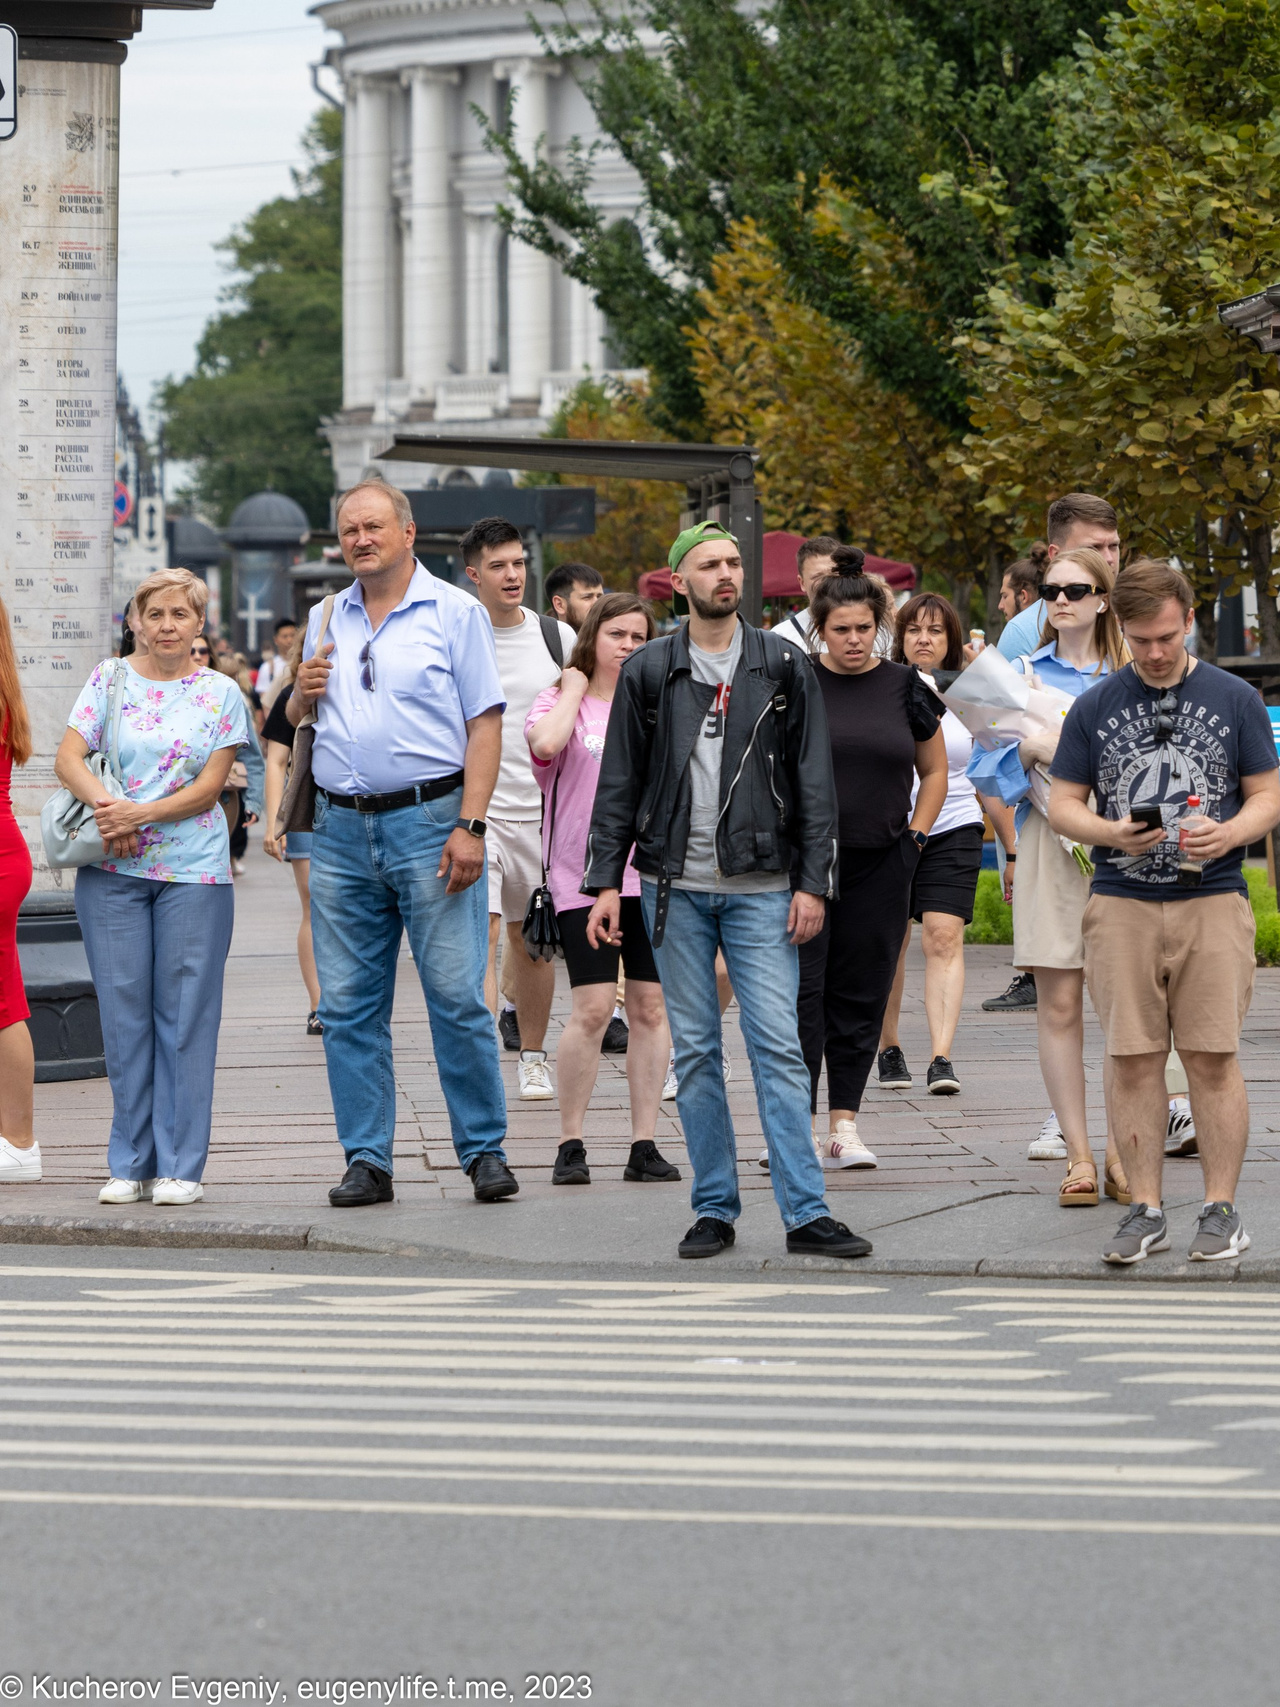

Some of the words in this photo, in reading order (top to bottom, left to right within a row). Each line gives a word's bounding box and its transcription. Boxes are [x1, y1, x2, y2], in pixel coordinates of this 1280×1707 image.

[59, 206, 89, 214] ВОСЕМЬ
[22, 241, 32, 250] 16,
[58, 252, 92, 260] ЧЕСТНАЯ
[58, 261, 96, 270] ЖЕНЩИНА
[21, 292, 30, 300] 18,
[58, 291, 84, 301] ВОЙНА
[19, 325, 28, 333] 25
[57, 326, 86, 335] ОТЕЛЛО
[19, 358, 29, 367] 26
[63, 360, 83, 368] ГОРЫ
[69, 368, 90, 378] ТОБОЙ
[18, 399, 29, 407] 28
[56, 400, 92, 408] ПРОЛЕТАЯ
[56, 410, 74, 418] НАД
[56, 419, 91, 427] КУКУШКИ
[18, 445, 28, 453] 30
[55, 445, 89, 453] РОДНИКИ
[55, 455, 83, 463] РАСУЛА
[55, 464, 94, 473] ГАМЗАТОВА
[54, 493, 95, 502] ДЕКАМЕРОН
[16, 531, 21, 539] 8
[54, 541, 91, 549] РОЖДЕНИЕ
[54, 551, 86, 560] СТАЛИНА
[15, 578, 25, 587] 13,
[26, 578, 34, 587] 14
[53, 583, 79, 593] ЧАЙКА
[52, 631, 58, 639] И
[59, 631, 93, 639] ЛЮДМИЛА
[1096, 700, 1230, 740] ADVENURES
[1104, 737, 1122, 756] THE
[1127, 716, 1200, 734] STREST
[1200, 732, 1224, 756] CREW
[1098, 766, 1117, 778] WIND
[1210, 764, 1228, 775] FREE
[1120, 758, 1148, 811] CRUISING
